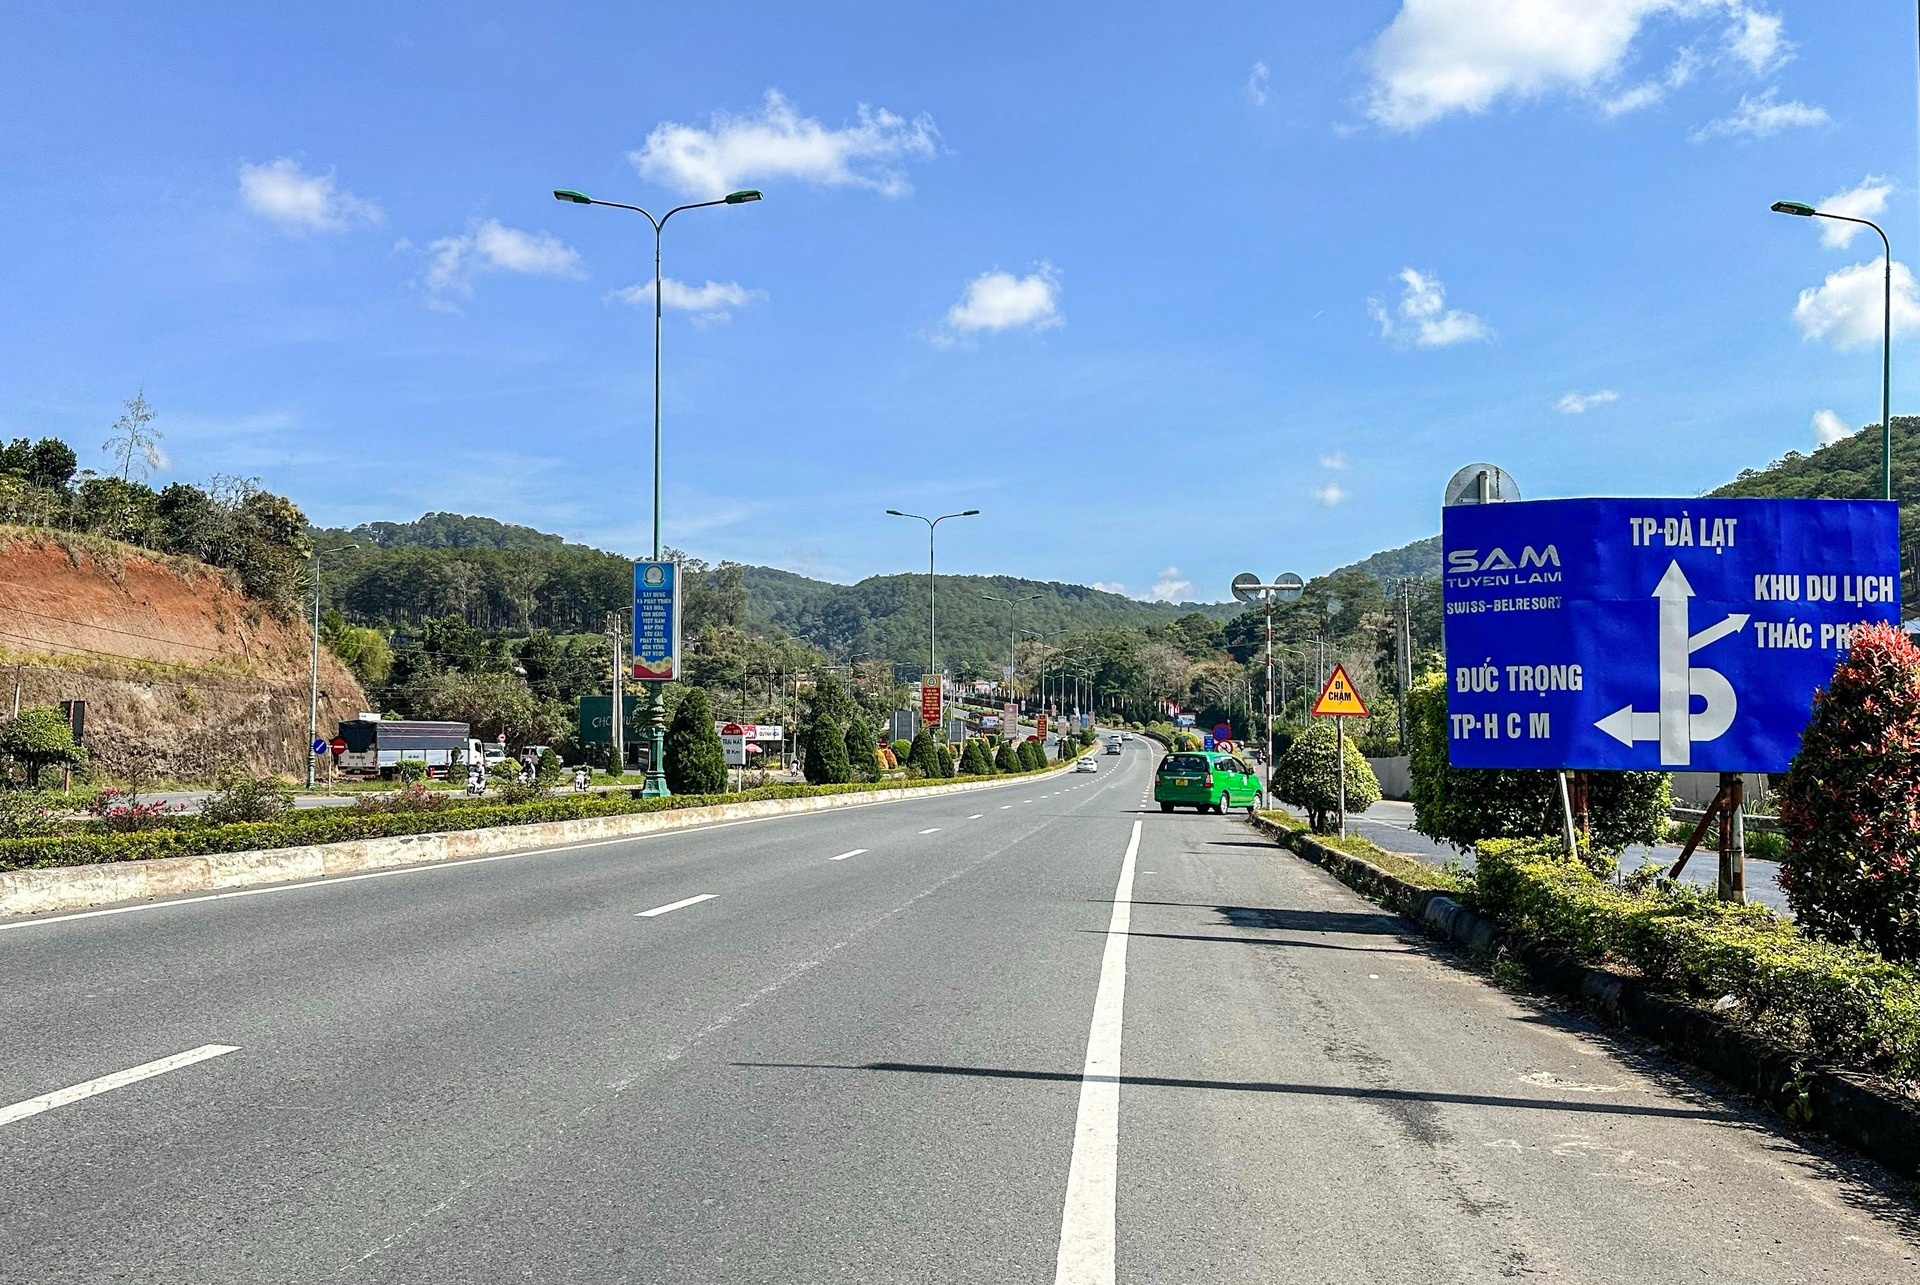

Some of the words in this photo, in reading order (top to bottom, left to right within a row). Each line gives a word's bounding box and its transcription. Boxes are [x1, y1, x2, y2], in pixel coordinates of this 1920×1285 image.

[1630, 511, 1694, 546] TP-ĐÀ
[1700, 518, 1737, 554] LẠT
[1448, 544, 1561, 573] SAM
[1515, 572, 1562, 584] LAM
[1755, 574, 1799, 600] KHU
[1806, 575, 1836, 601] DU
[1844, 575, 1893, 607] LỊCH
[1754, 618, 1812, 649] THÁC
[1335, 681, 1343, 689] ĐI
[1456, 657, 1499, 692] ĐỨC
[1506, 664, 1582, 697] TRỌNG
